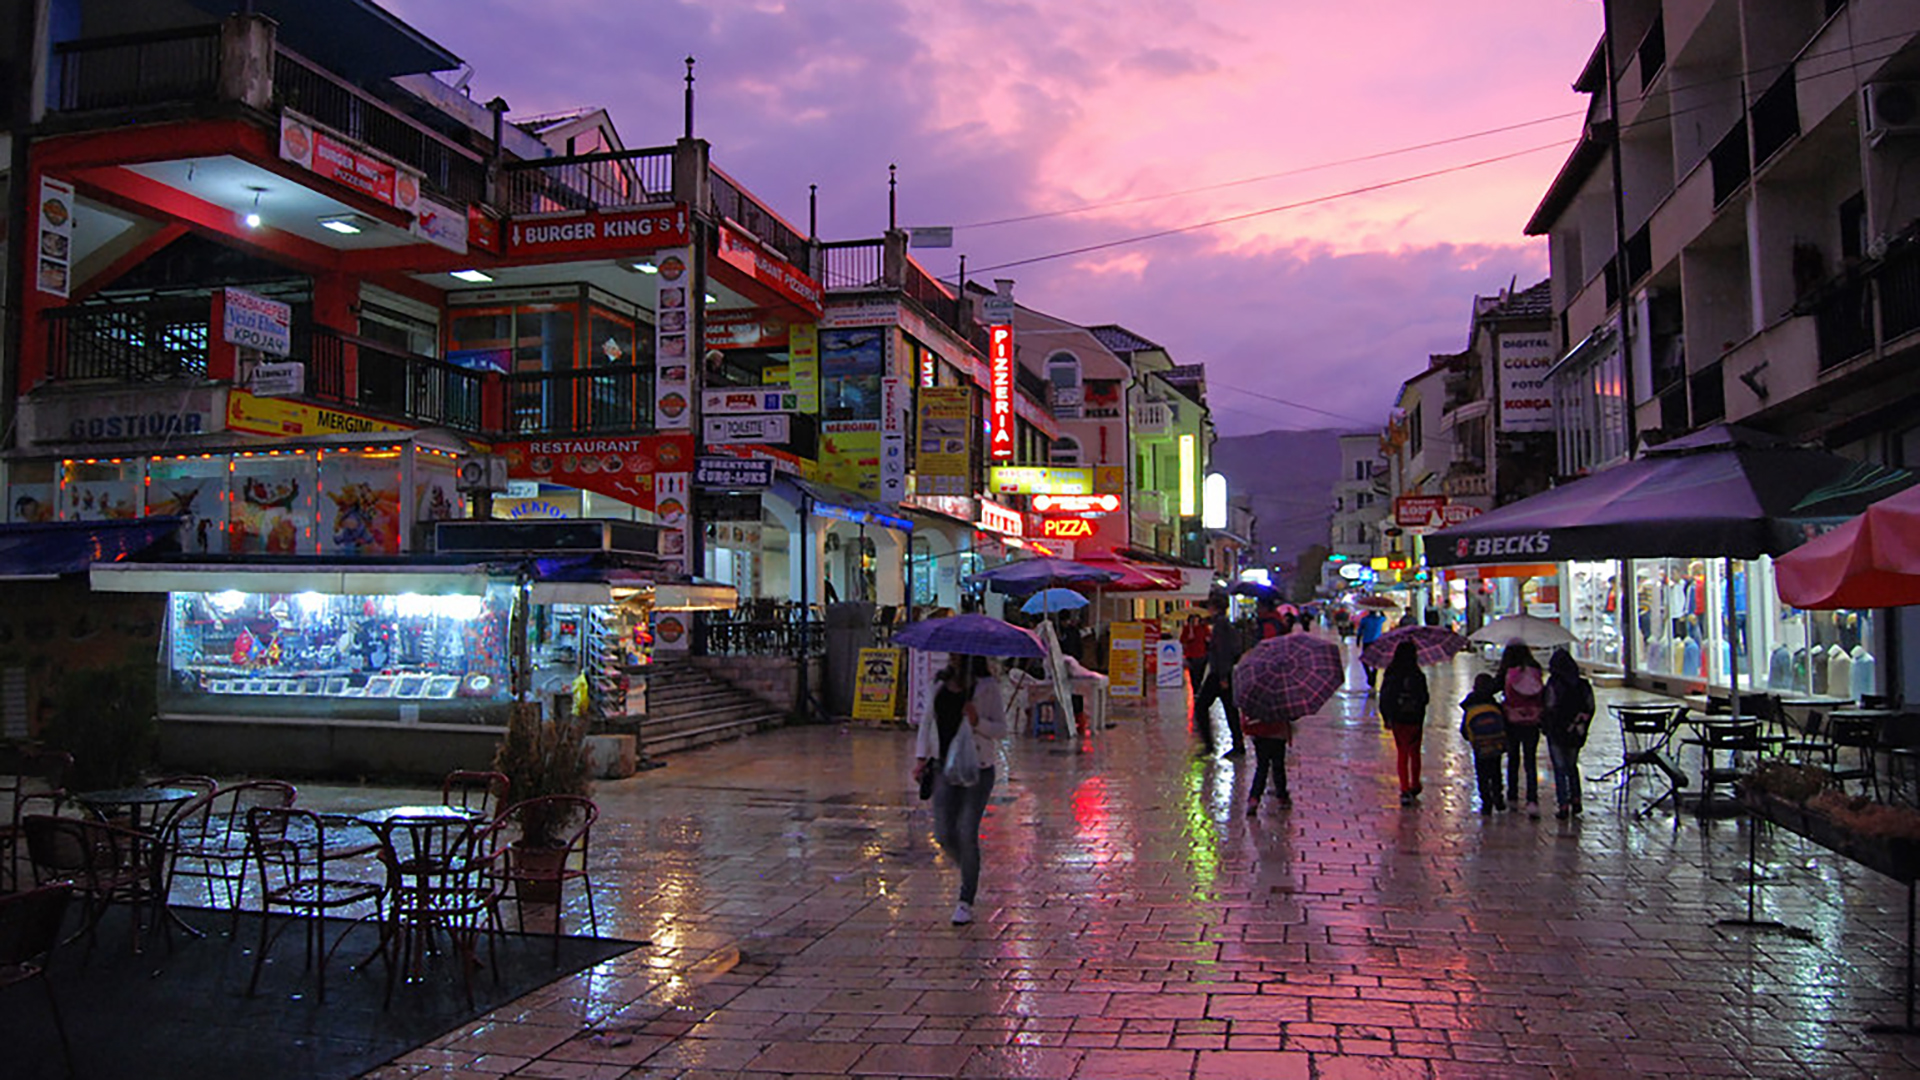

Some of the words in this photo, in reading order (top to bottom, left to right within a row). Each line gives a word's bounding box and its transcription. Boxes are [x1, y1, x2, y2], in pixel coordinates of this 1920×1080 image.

[525, 222, 596, 244] BURGER
[603, 217, 671, 238] KING'S
[1502, 339, 1550, 349] DIGITAL
[1503, 357, 1552, 369] COLOR
[993, 329, 1010, 442] PIZZERIA
[1511, 380, 1544, 390] FOTO
[1084, 407, 1120, 418] PIZZA
[70, 413, 202, 438] GOSTIVAR
[317, 410, 374, 434] MERGIMI
[726, 420, 763, 434] TOILETTE
[825, 421, 878, 433] MERGIMI
[530, 440, 641, 454] RESTAURANT
[1044, 520, 1093, 537] PIZZA
[1474, 530, 1551, 556] BECK'S
